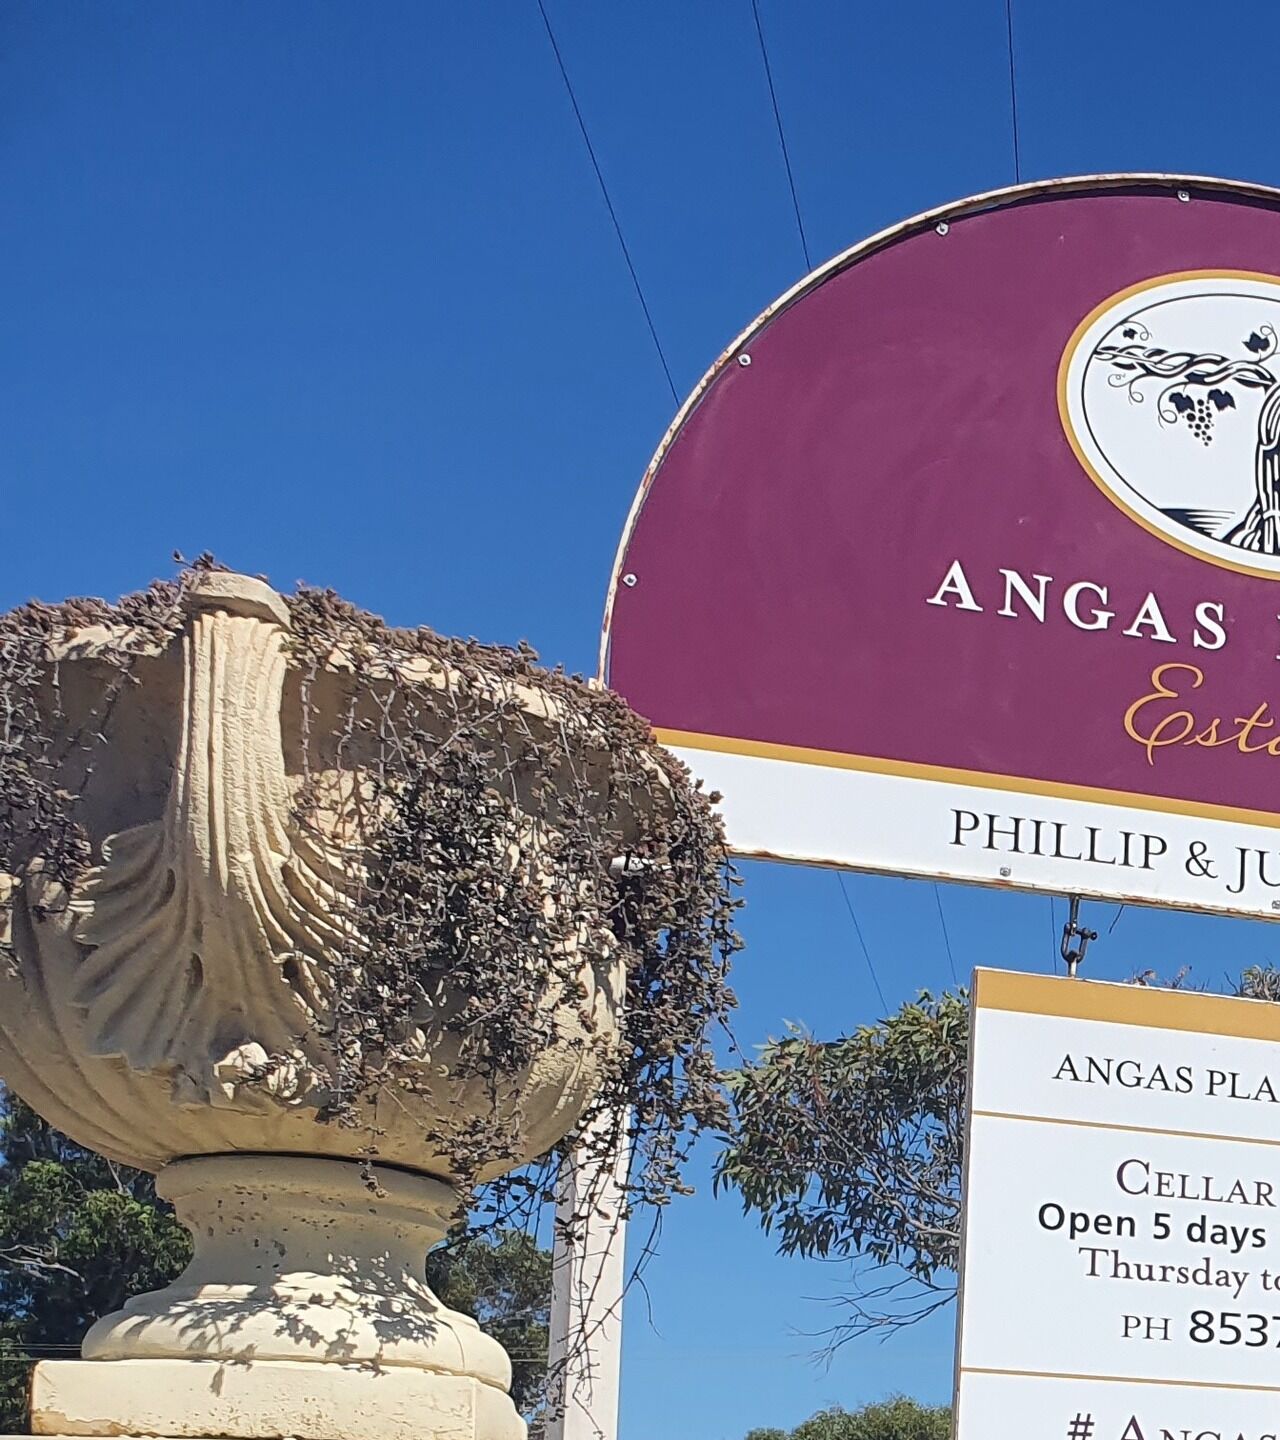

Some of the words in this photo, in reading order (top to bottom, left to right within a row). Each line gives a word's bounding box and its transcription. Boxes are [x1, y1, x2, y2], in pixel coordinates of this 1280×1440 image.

[926, 559, 1228, 649] ANGAS
[950, 809, 1168, 870] PHILLIP
[1185, 840, 1218, 879] &
[1052, 1054, 1193, 1094] ANGAS
[1038, 1202, 1136, 1240] Open
[1153, 1213, 1171, 1240] 5
[1186, 1214, 1266, 1254] days
[1078, 1244, 1250, 1300] Thursday
[1122, 1315, 1170, 1341] PH
